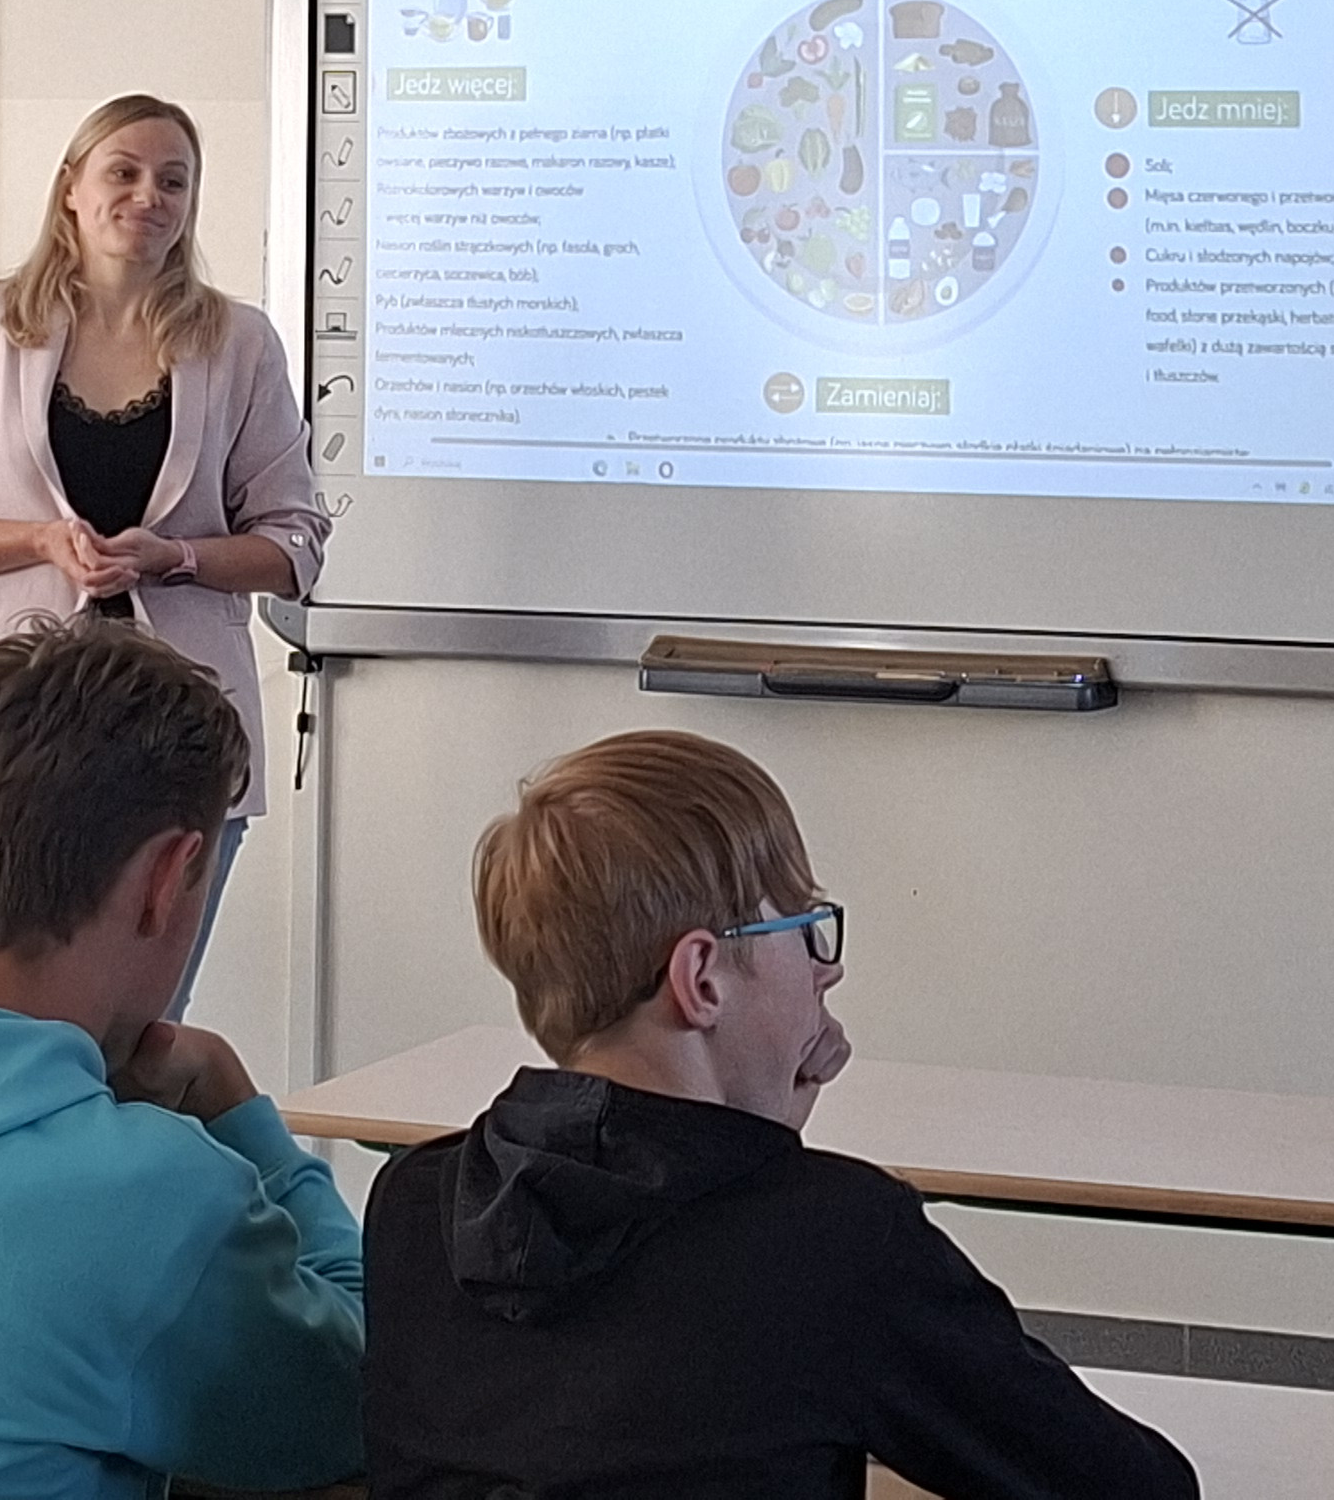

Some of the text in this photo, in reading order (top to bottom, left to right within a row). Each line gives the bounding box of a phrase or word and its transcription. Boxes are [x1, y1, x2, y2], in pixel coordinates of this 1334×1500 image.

[394, 73, 442, 95] Jedz
[1155, 96, 1288, 124] Jedz mniej:
[1145, 248, 1185, 263] Cukru
[1145, 278, 1216, 293] Produktów
[827, 382, 941, 412] Zamieniaj:
